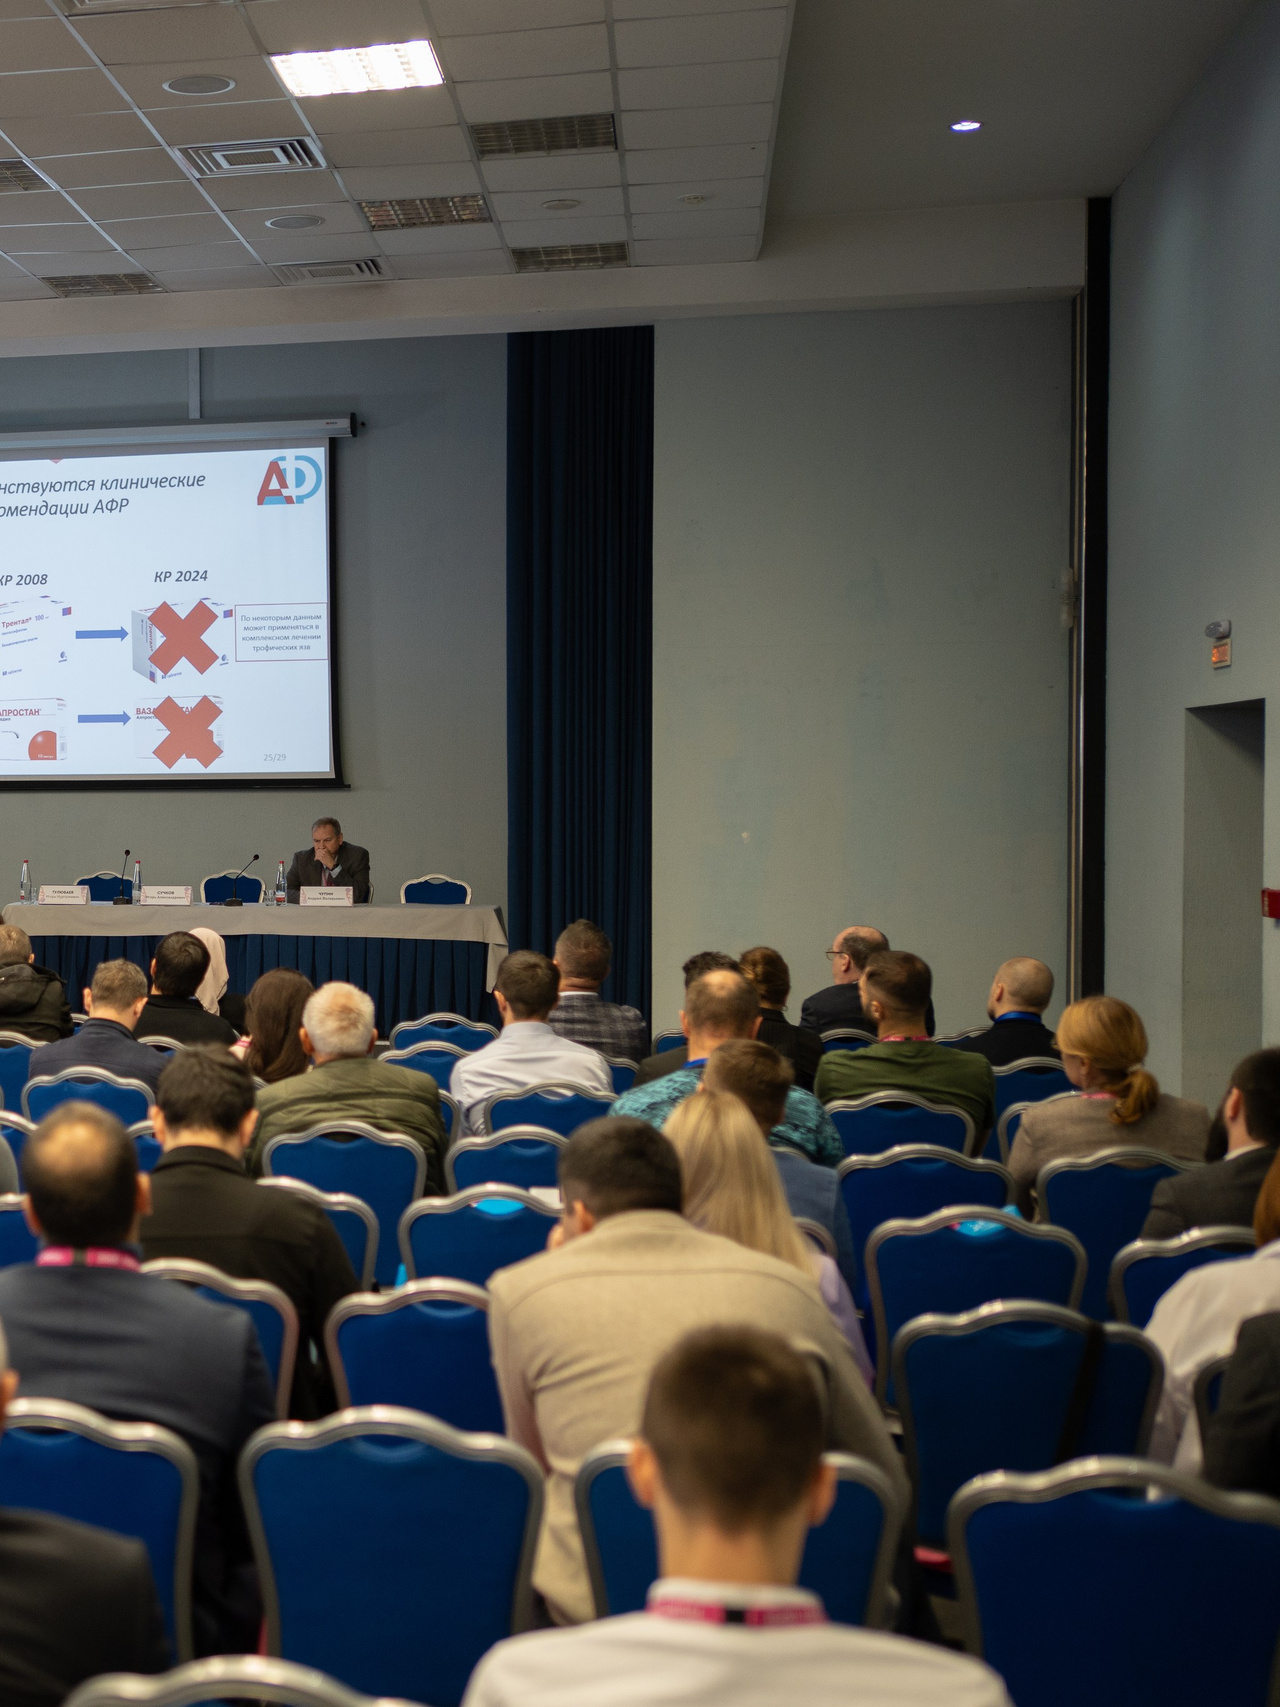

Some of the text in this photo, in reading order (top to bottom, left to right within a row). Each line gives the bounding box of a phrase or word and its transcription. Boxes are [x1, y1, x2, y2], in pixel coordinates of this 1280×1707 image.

[99, 473, 206, 490] клинические
[93, 498, 129, 514] АФР
[16, 574, 48, 586] 2008
[154, 570, 208, 582] КР 2024
[293, 614, 322, 622] данным
[268, 624, 314, 632] применяться
[253, 644, 297, 652] трофических
[263, 754, 287, 762] 25/29
